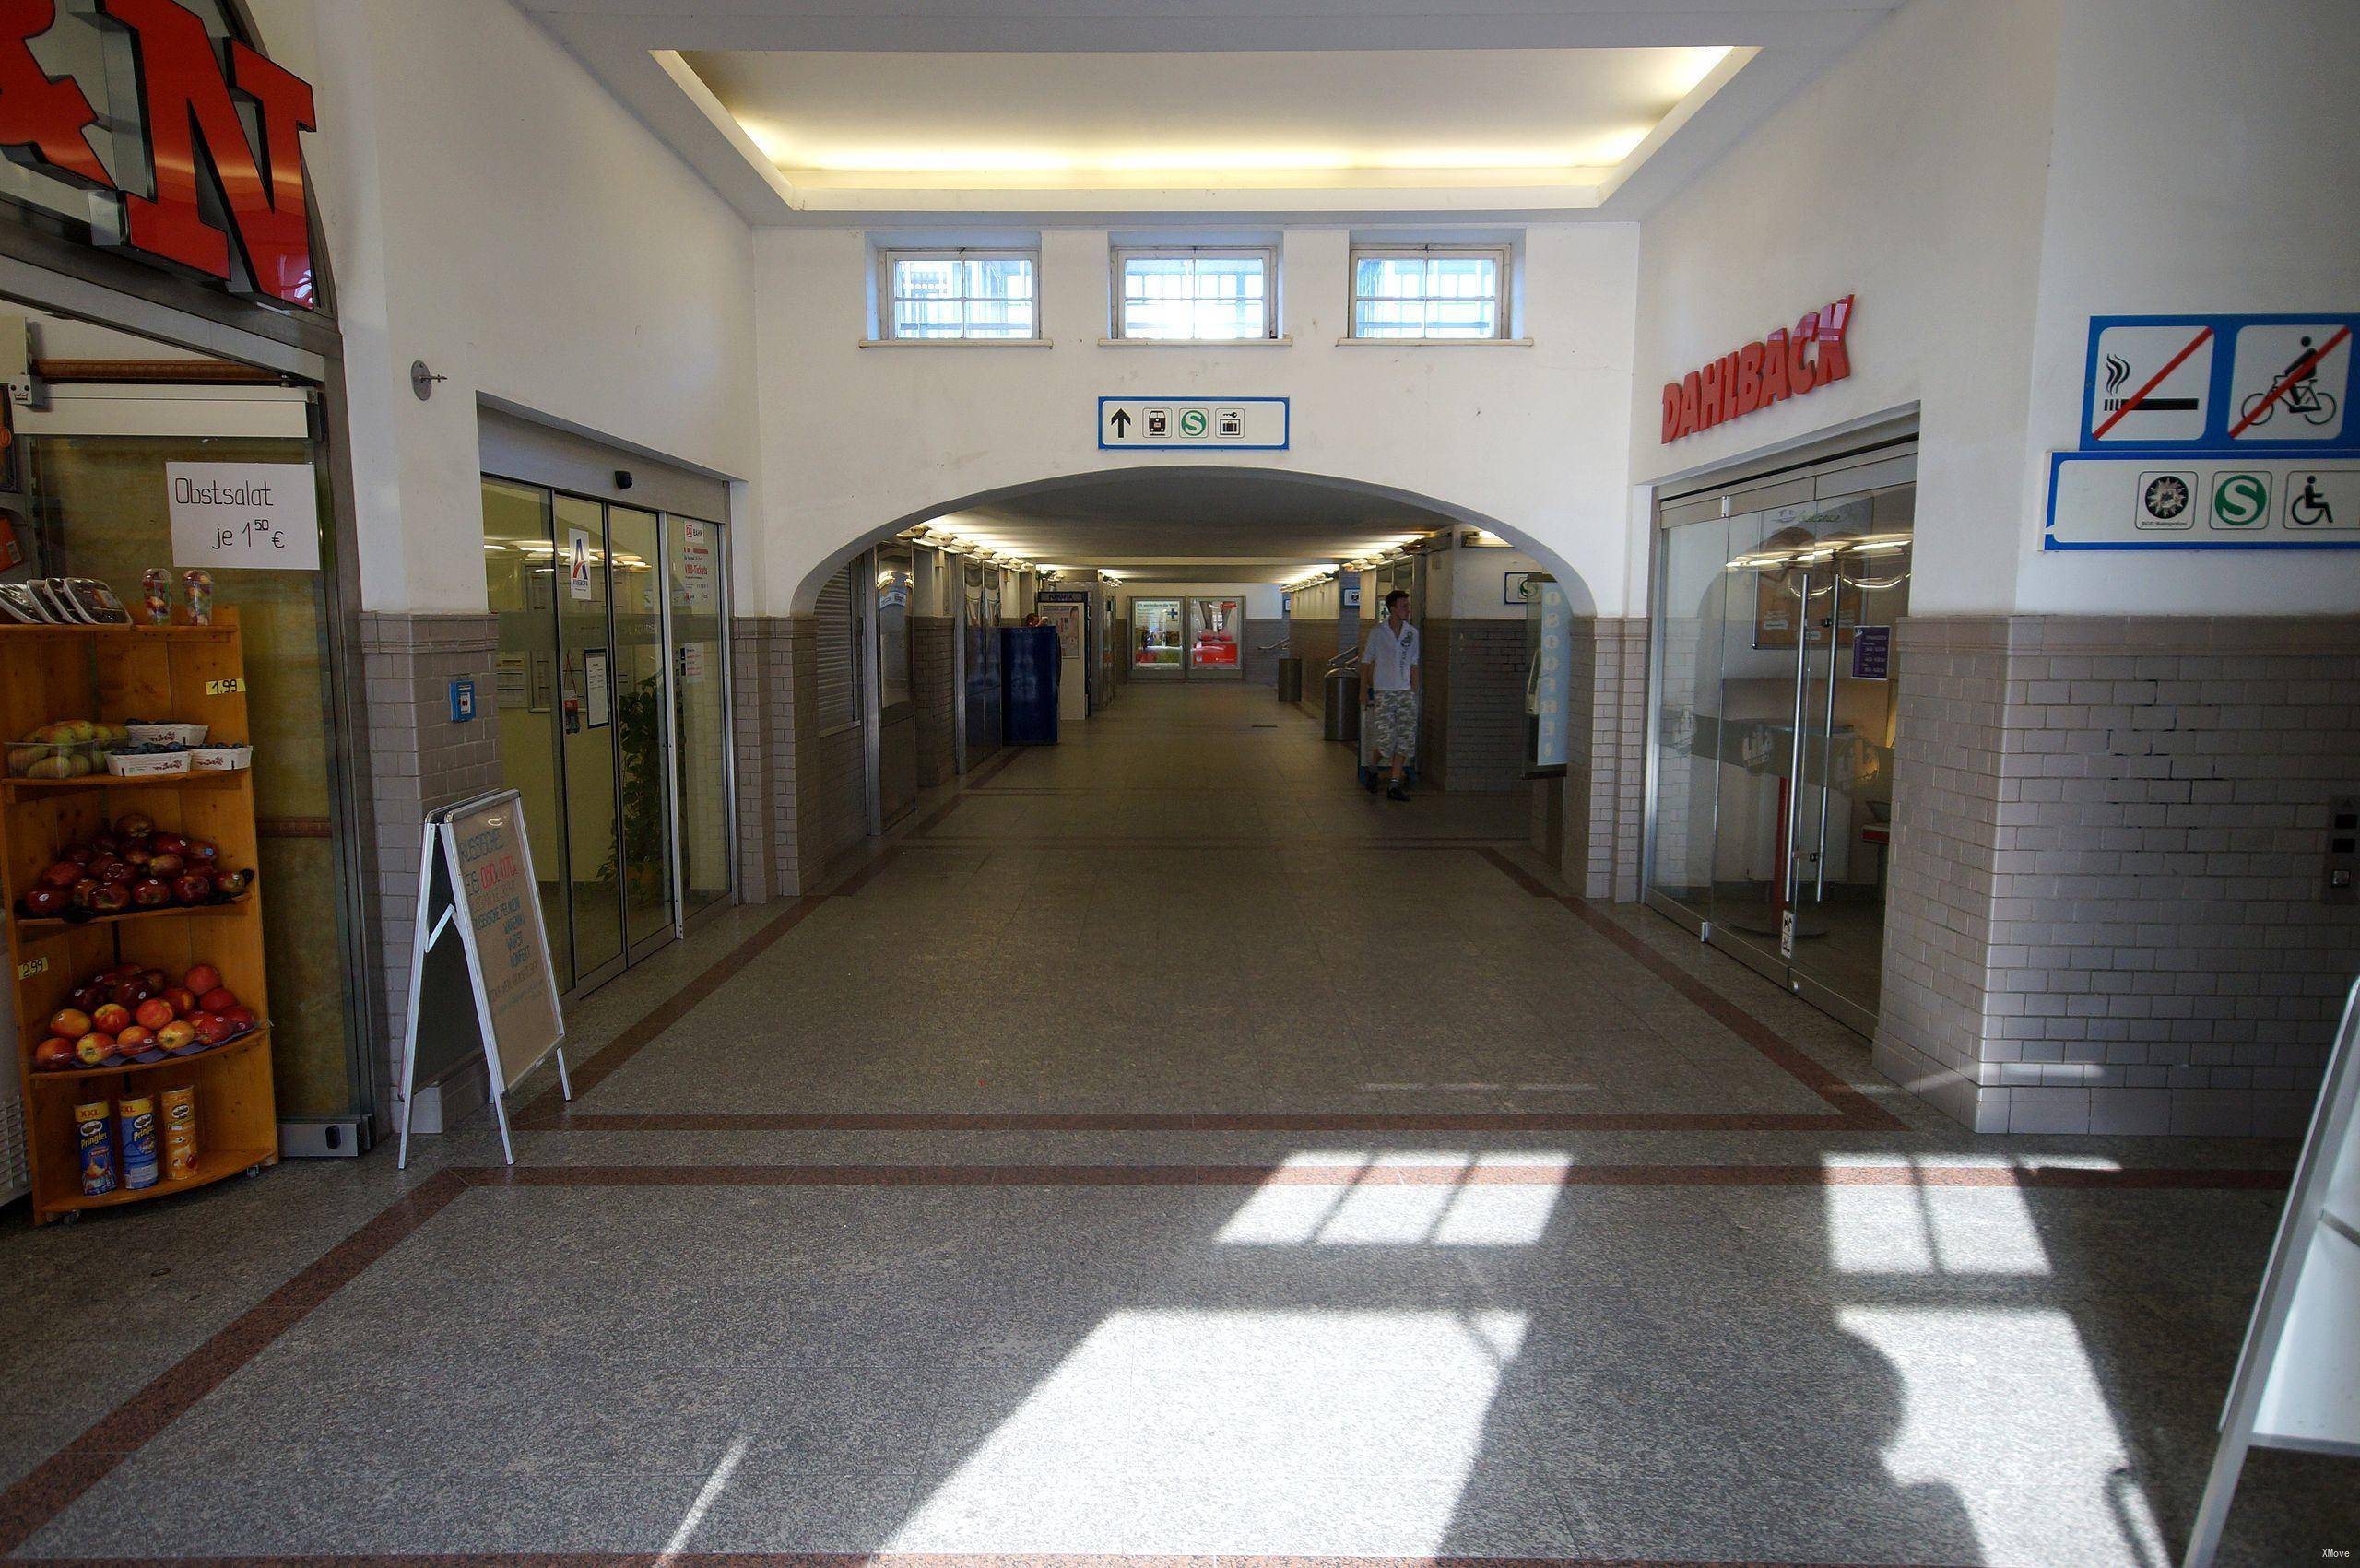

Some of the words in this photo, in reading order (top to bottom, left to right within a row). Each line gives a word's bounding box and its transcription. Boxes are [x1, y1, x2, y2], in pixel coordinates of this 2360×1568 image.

[1662, 294, 1855, 444] DAHLBACK
[175, 477, 274, 507] Obstsalat
[212, 525, 233, 550] je
[80, 1132, 108, 1150] Pringles
